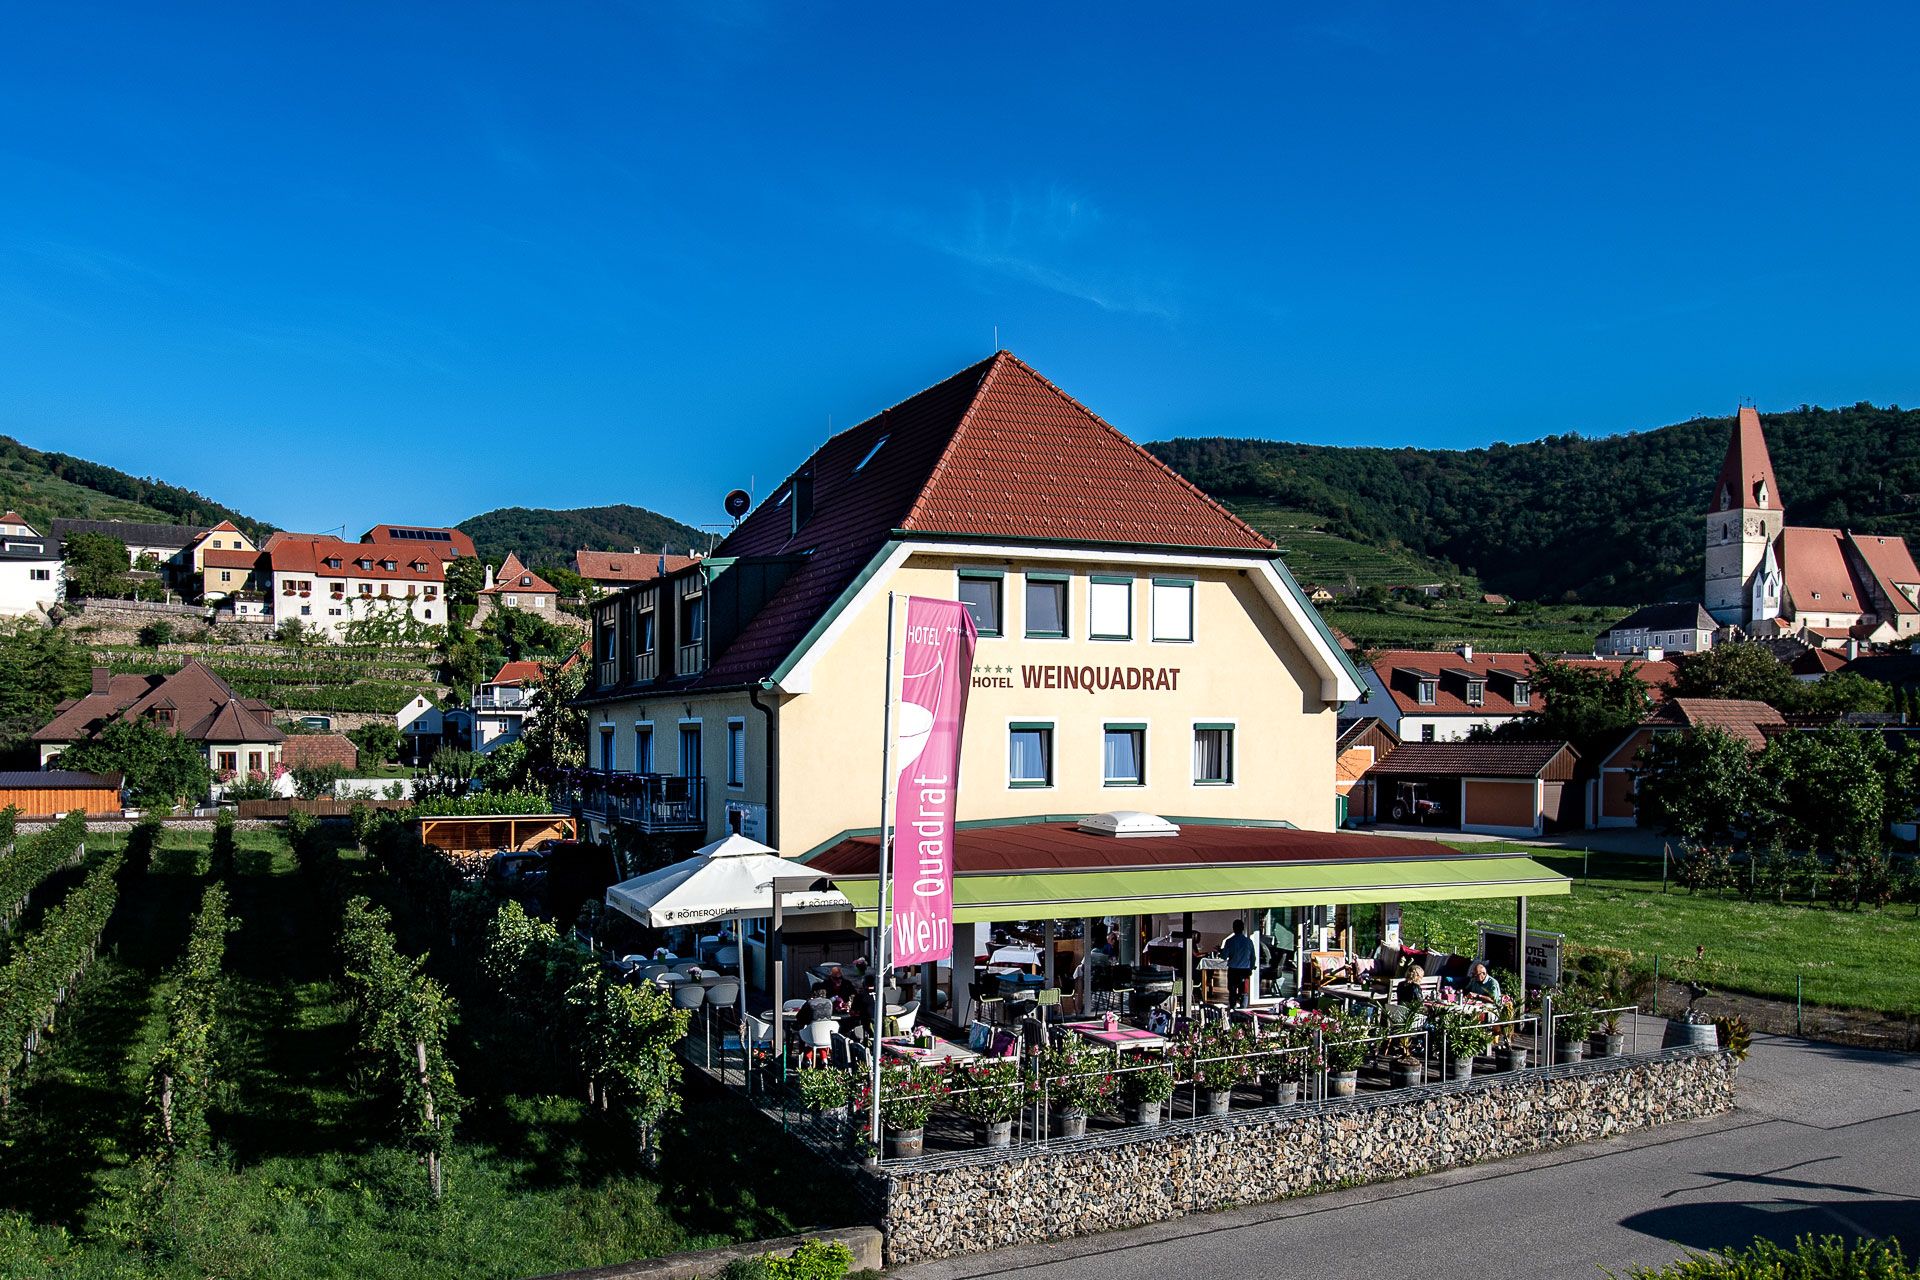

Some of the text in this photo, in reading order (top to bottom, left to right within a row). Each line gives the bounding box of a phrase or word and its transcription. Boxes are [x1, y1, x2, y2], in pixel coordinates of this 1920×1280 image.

[907, 624, 941, 646] HOTEL
[972, 664, 1181, 695] HOTEL WEINQUADRAT
[911, 772, 948, 897] Quadrat
[896, 911, 950, 956] Wein
[1525, 956, 1547, 968] ARNI
[1526, 945, 1548, 958] OTEL
